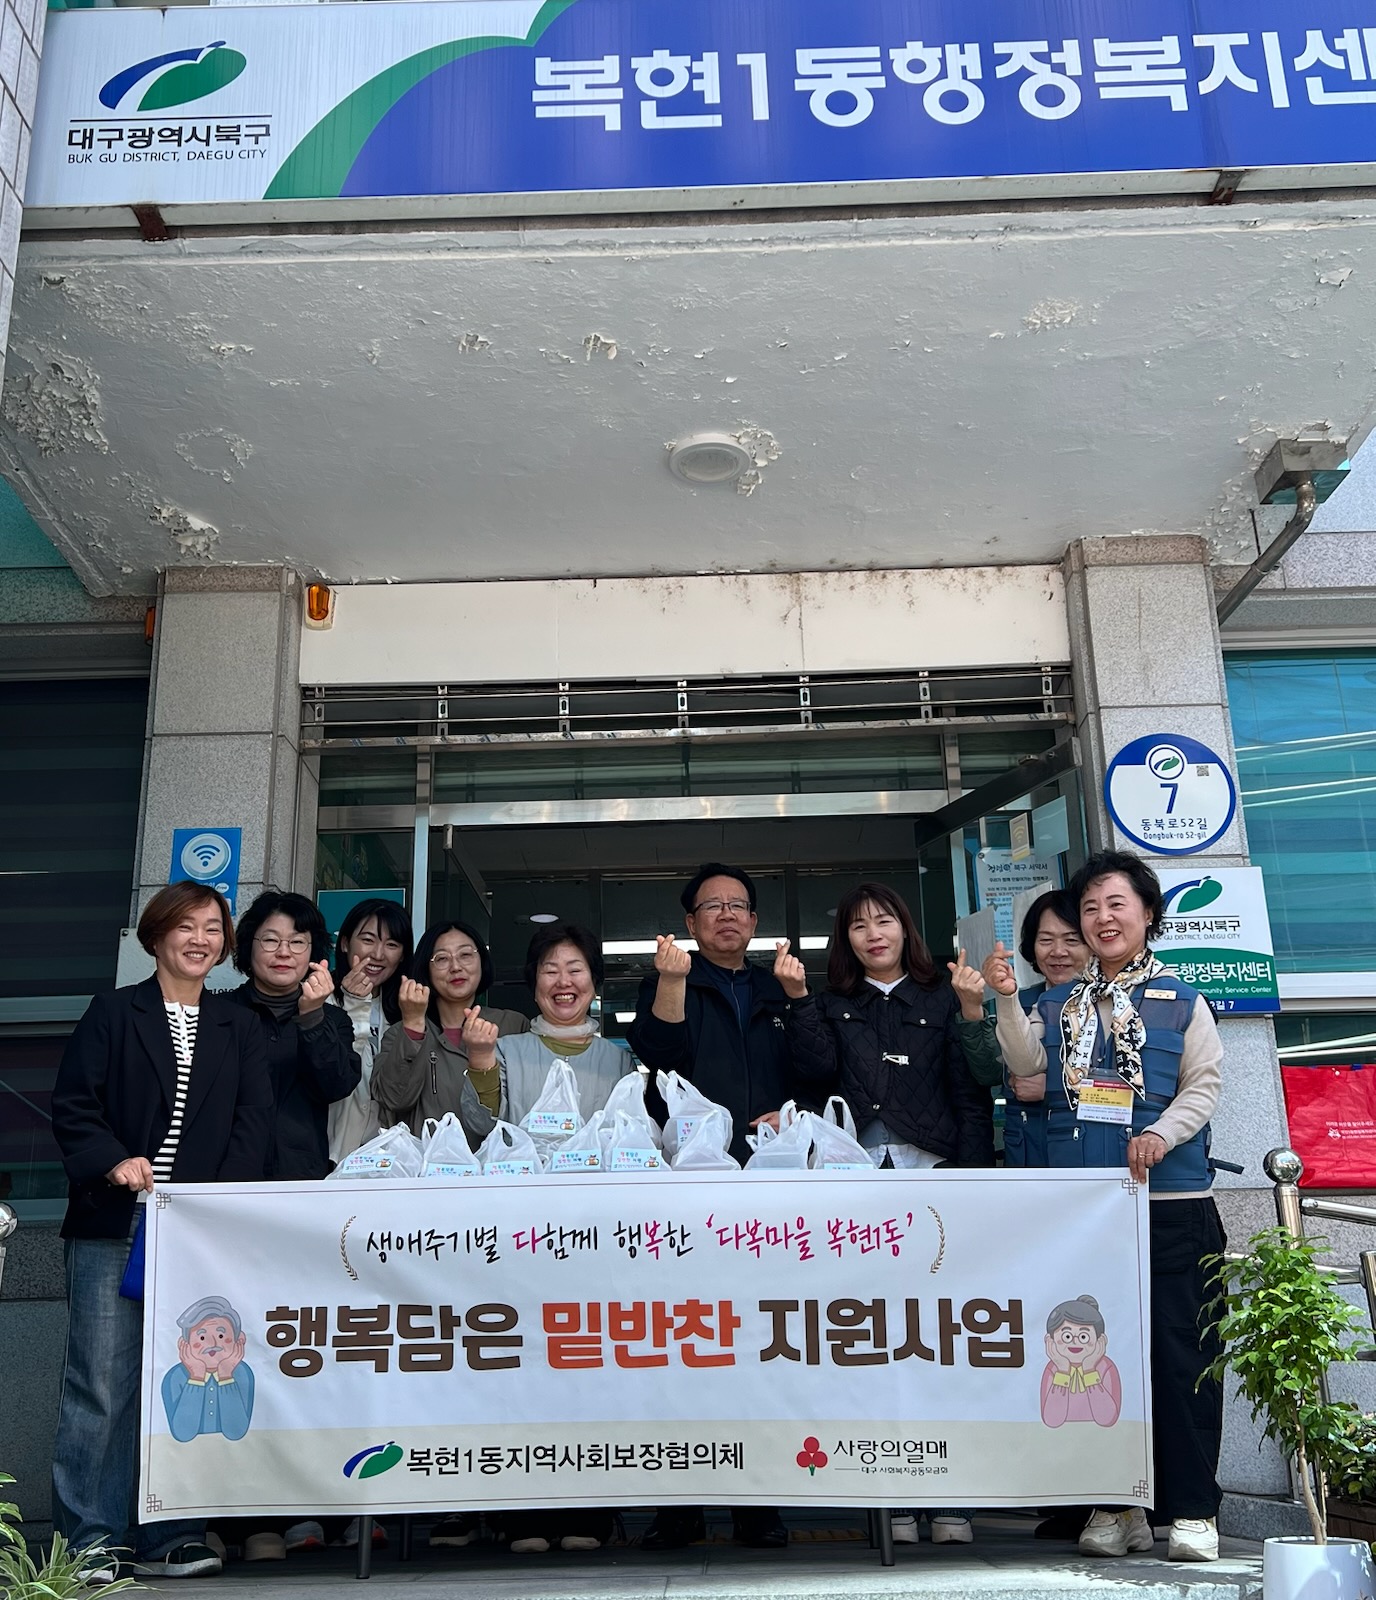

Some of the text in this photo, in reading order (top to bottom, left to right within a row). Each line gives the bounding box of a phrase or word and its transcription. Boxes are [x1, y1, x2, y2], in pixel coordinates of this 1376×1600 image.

[67, 123, 271, 150] 대구광역시북구
[67, 148, 267, 164] BUK GU DISTRICT, DAEGU CITY
[1159, 783, 1179, 815] 7
[1140, 817, 1208, 832] 동북로52길
[1143, 830, 1207, 841] Dongbuk-ro 52-gil
[1163, 920, 1241, 933] 구광역시북구
[1225, 986, 1249, 994] Service
[1251, 985, 1272, 993] Center
[1228, 1000, 1235, 1010] 7
[366, 1225, 500, 1264] 생애주기별
[512, 1222, 598, 1260] 다함께
[613, 1220, 693, 1260] 행복한
[265, 1297, 1026, 1378] 행복담은 밑반찬 지원사업
[406, 1441, 746, 1477] 복현1동지역사회보장협의체
[833, 1439, 948, 1465] 사랑의열매
[861, 1466, 949, 1477] 대구 사회복지공동모금회
